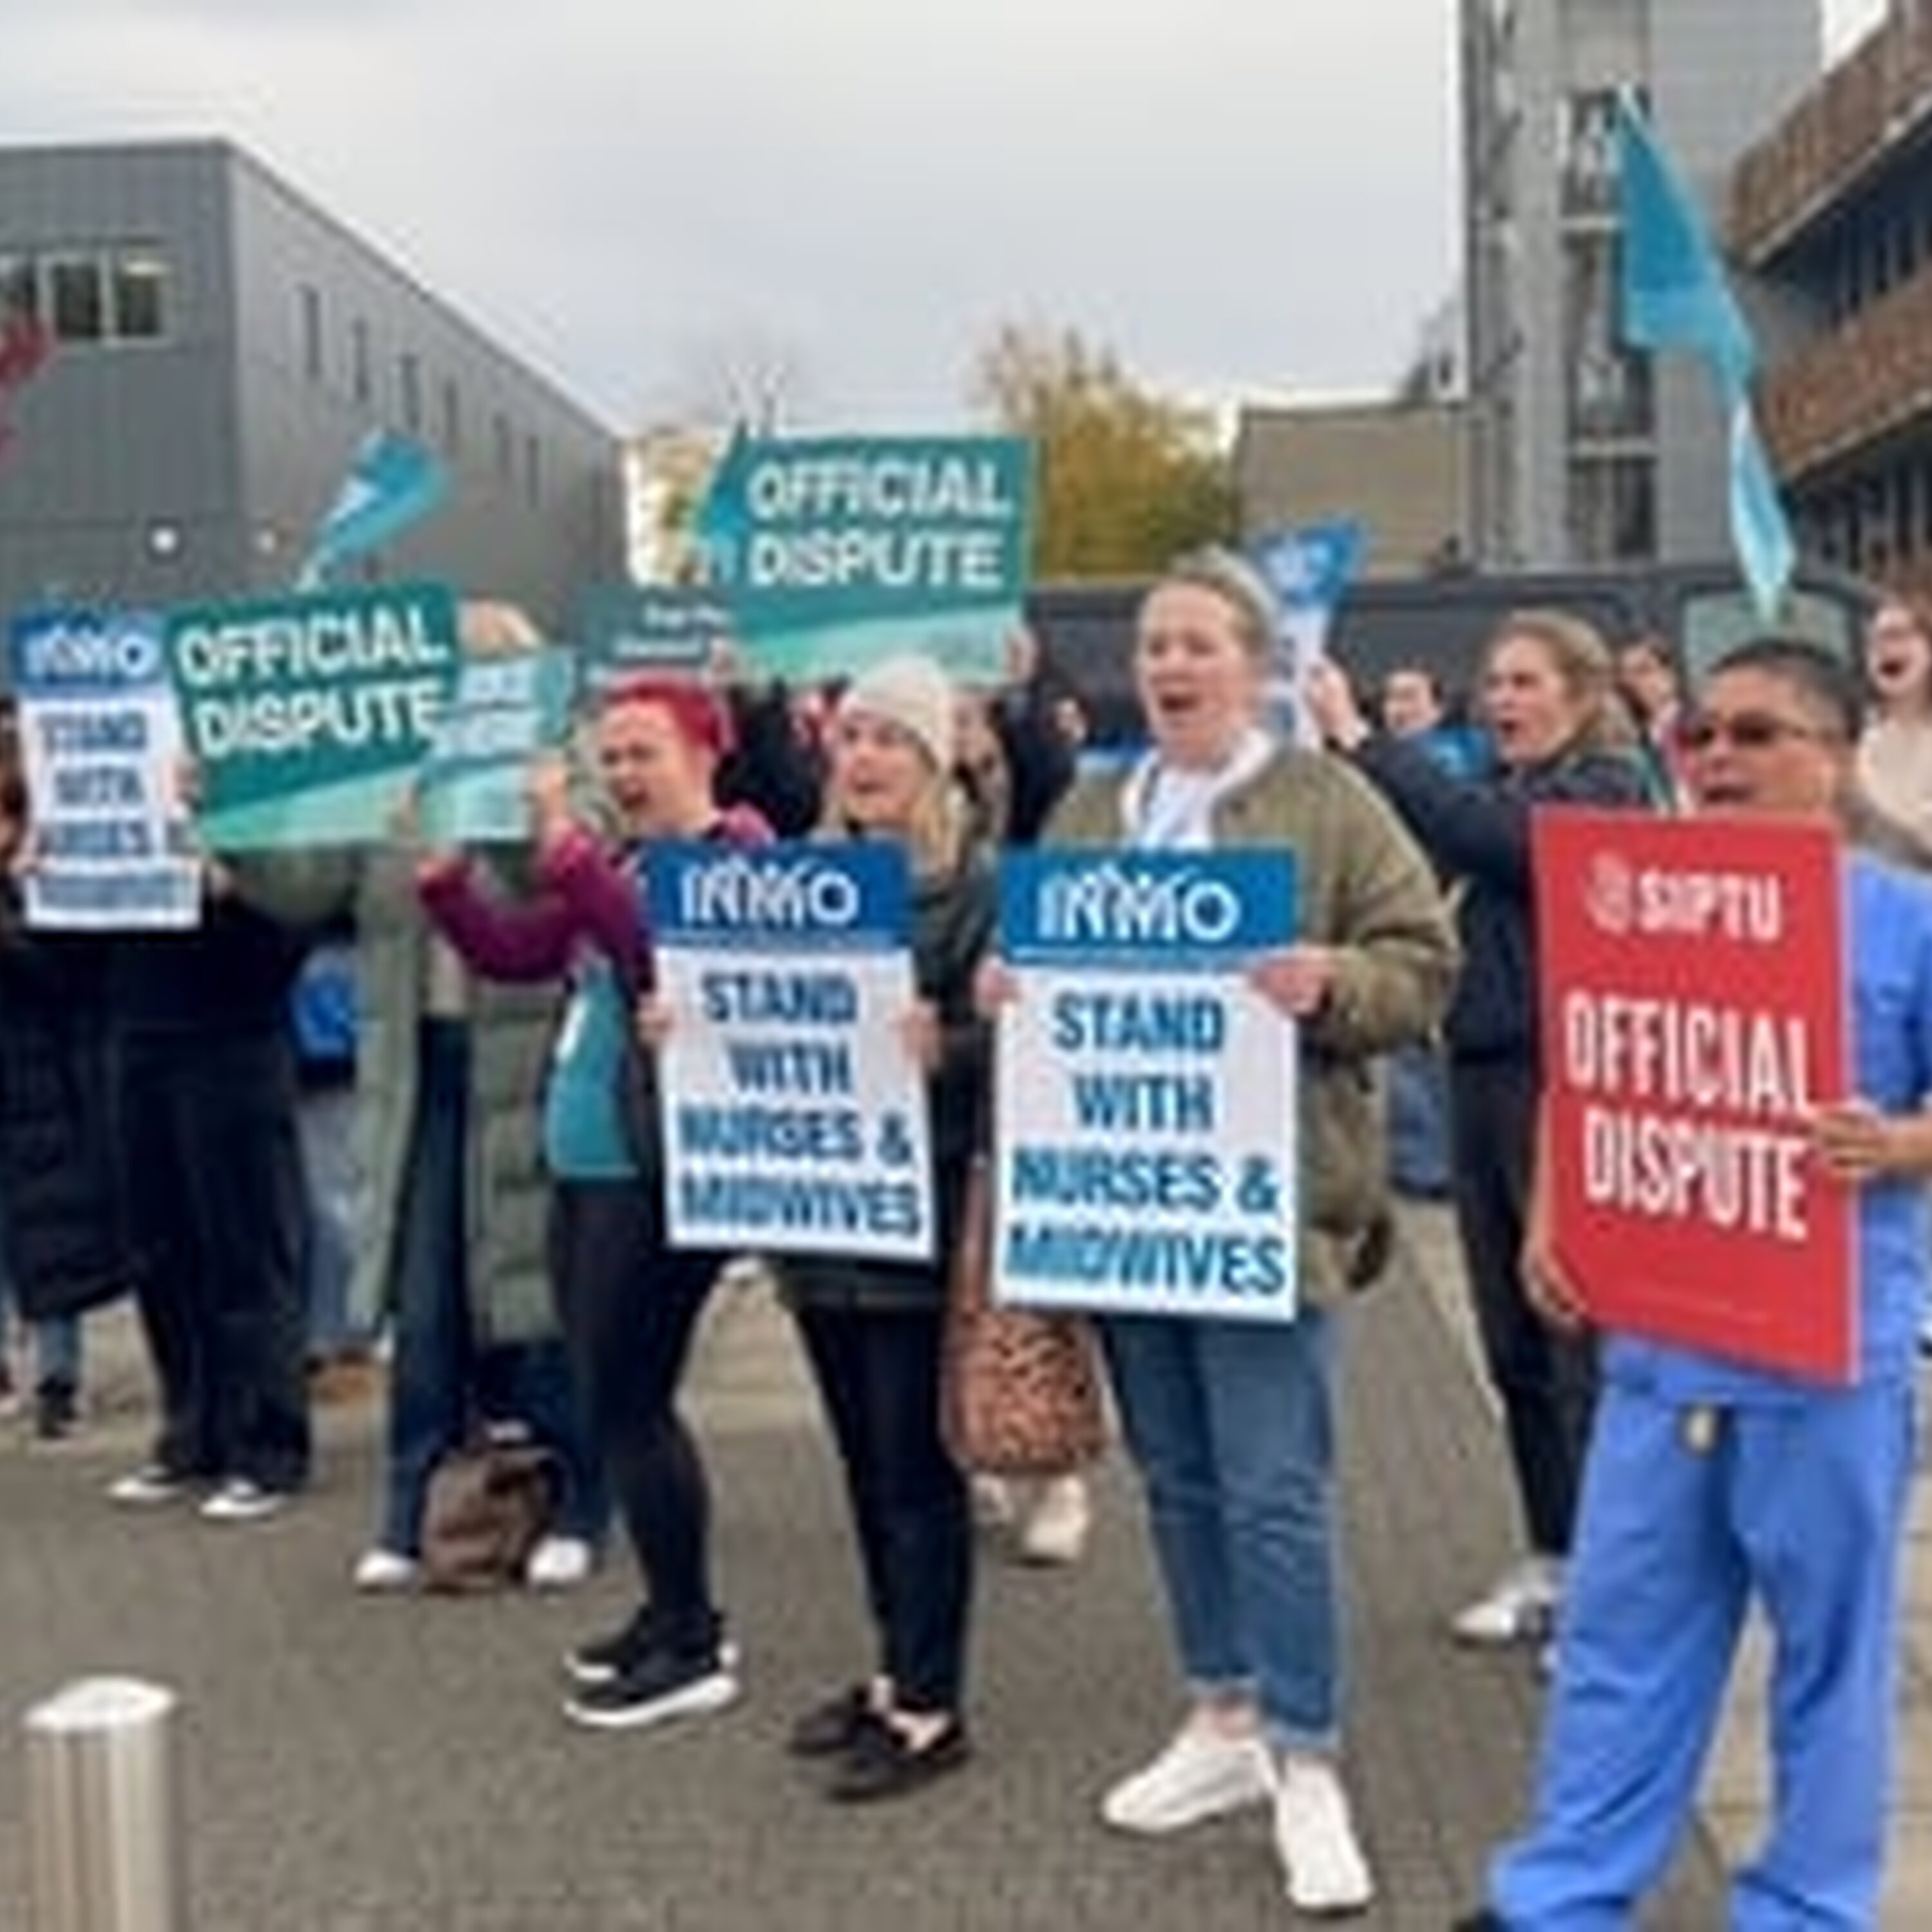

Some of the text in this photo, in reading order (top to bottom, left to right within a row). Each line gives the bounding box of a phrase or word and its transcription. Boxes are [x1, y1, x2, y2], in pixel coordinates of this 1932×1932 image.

[746, 456, 1012, 521] OFFICIAL
[749, 529, 1004, 589] DISPUTE
[175, 602, 450, 687] OFFICIAL
[195, 675, 446, 759] DISPUTE
[681, 853, 860, 925] INMO
[1037, 861, 1241, 941] INMO
[1638, 867, 1782, 942] SIPTU
[701, 972, 858, 1024] STAND
[1054, 991, 1224, 1052] STAND
[726, 1039, 853, 1094] WITH
[1564, 989, 1814, 1115] OFFICIAL
[679, 1107, 913, 1166] NURSES &
[1074, 1074, 1214, 1132] WITH
[681, 1172, 921, 1238] MIDWIVES
[1011, 1146, 1277, 1213] NURSES &
[1583, 1105, 1806, 1243] DISPUTE
[1005, 1225, 1285, 1294] MIDWIVES
